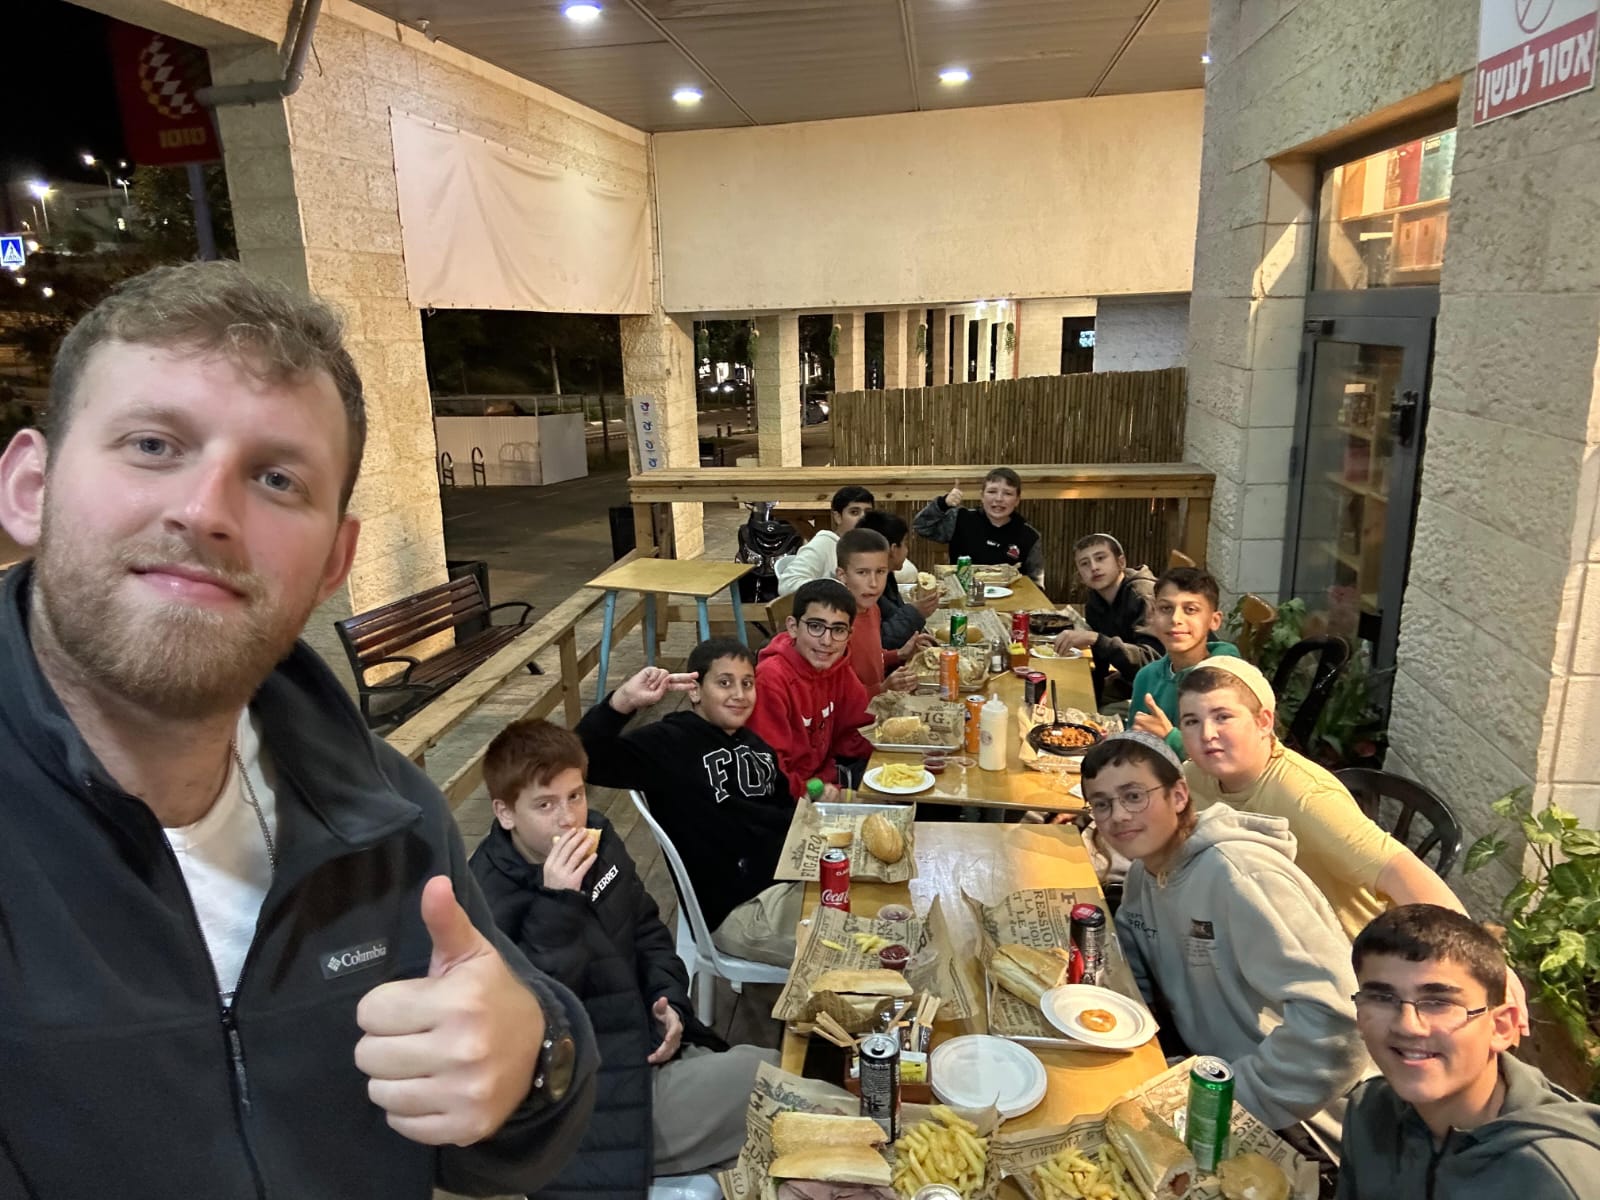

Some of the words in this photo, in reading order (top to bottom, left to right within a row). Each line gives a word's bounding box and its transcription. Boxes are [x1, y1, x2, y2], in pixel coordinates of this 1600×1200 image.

[1477, 44, 1536, 119] לעשן!
[1538, 29, 1594, 88] אסור
[801, 834, 823, 878] FIGARO
[341, 944, 387, 967] Columbia
